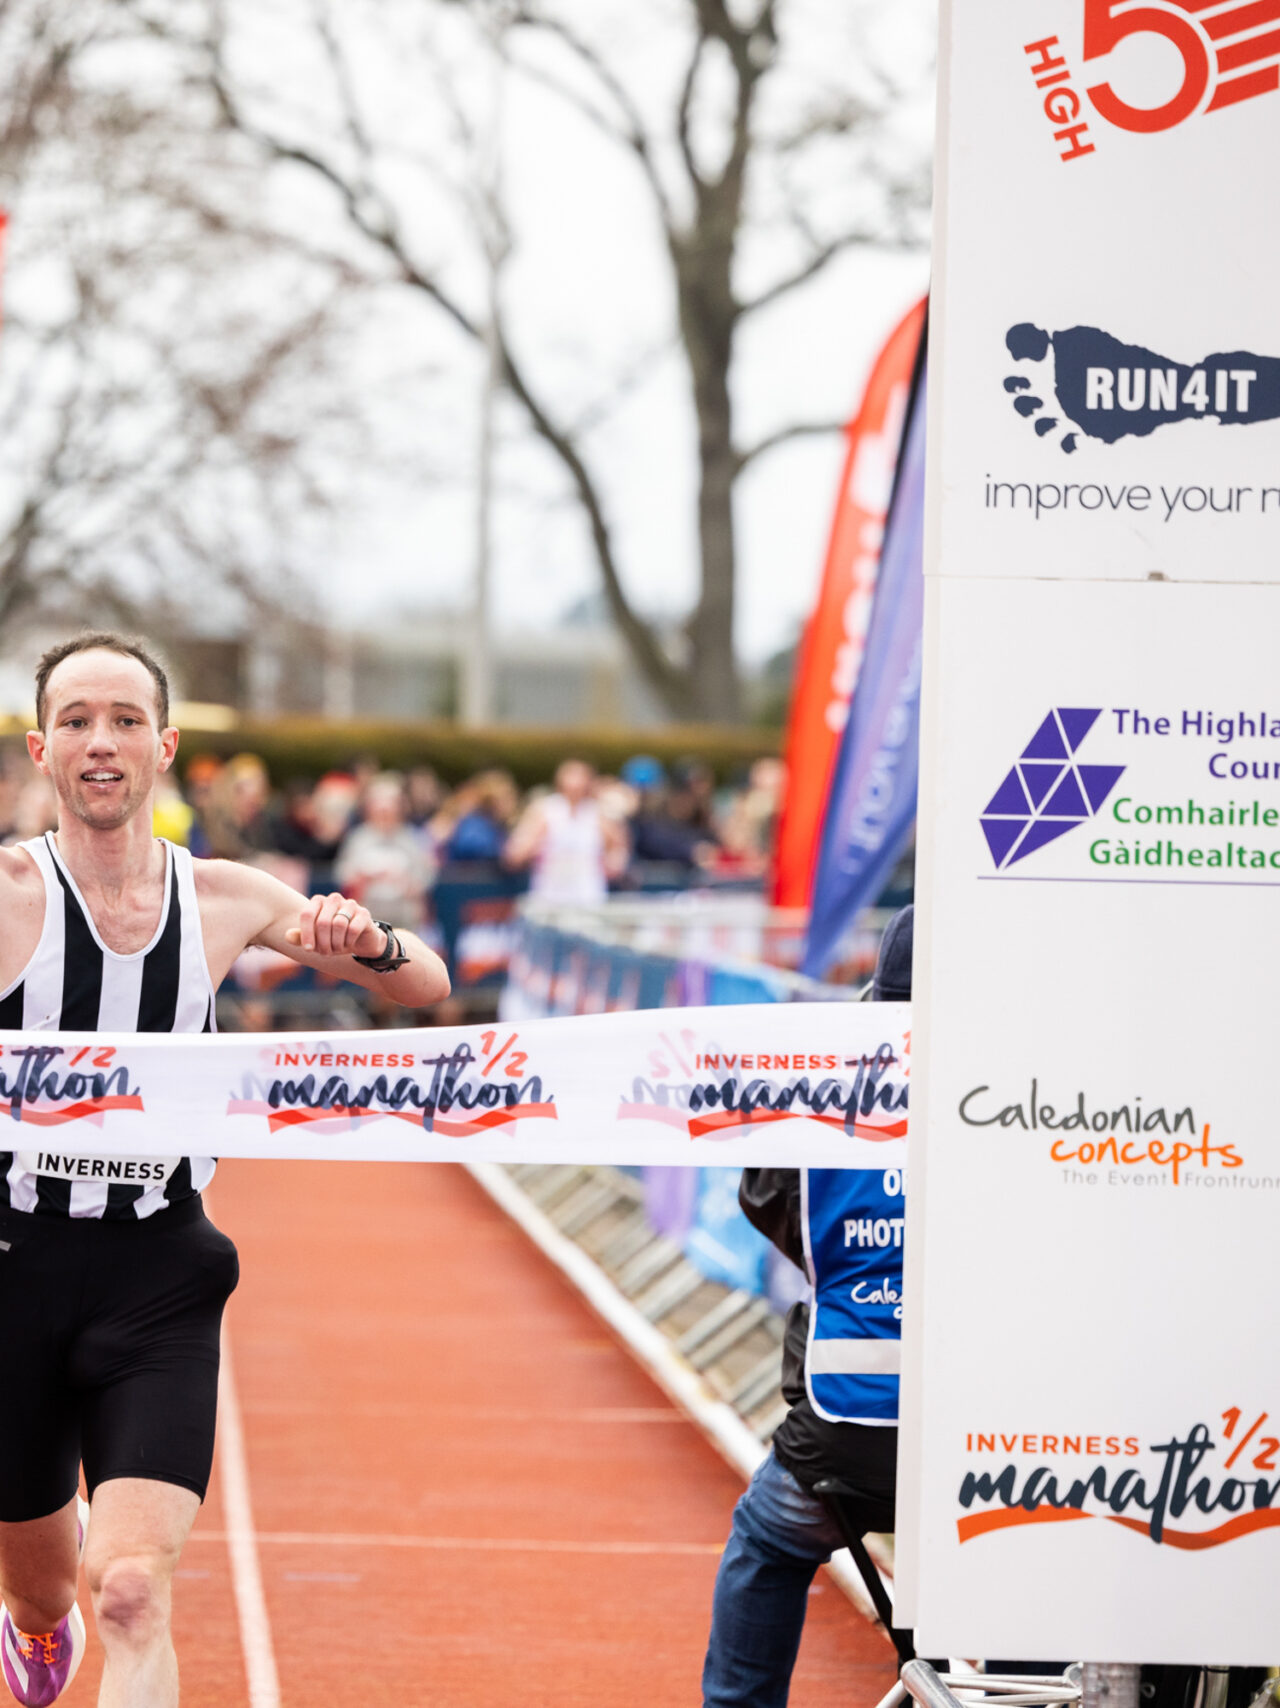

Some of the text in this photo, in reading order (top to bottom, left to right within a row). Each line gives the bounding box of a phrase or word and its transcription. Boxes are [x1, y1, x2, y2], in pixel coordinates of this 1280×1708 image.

[1024, 35, 1096, 162] HIGH
[1086, 367, 1257, 413] RUN4IT
[985, 473, 1152, 520] improve
[1160, 485, 1253, 523] your
[1112, 708, 1171, 736] The
[1113, 797, 1280, 827] Comhairle
[274, 1030, 529, 1078] INVERNESS 1/2
[695, 1053, 838, 1071] INVERNESS
[268, 1042, 554, 1132] marathon
[688, 1042, 909, 1138] marath
[959, 1077, 1196, 1135] Caledonian
[36, 1152, 166, 1181] INVERNESS
[1050, 1123, 1244, 1186] concepts
[1062, 1168, 1099, 1186] The
[1108, 1170, 1168, 1187] Event
[843, 1218, 905, 1248] PHOT
[966, 1406, 1280, 1471] INVERNESS 1/2
